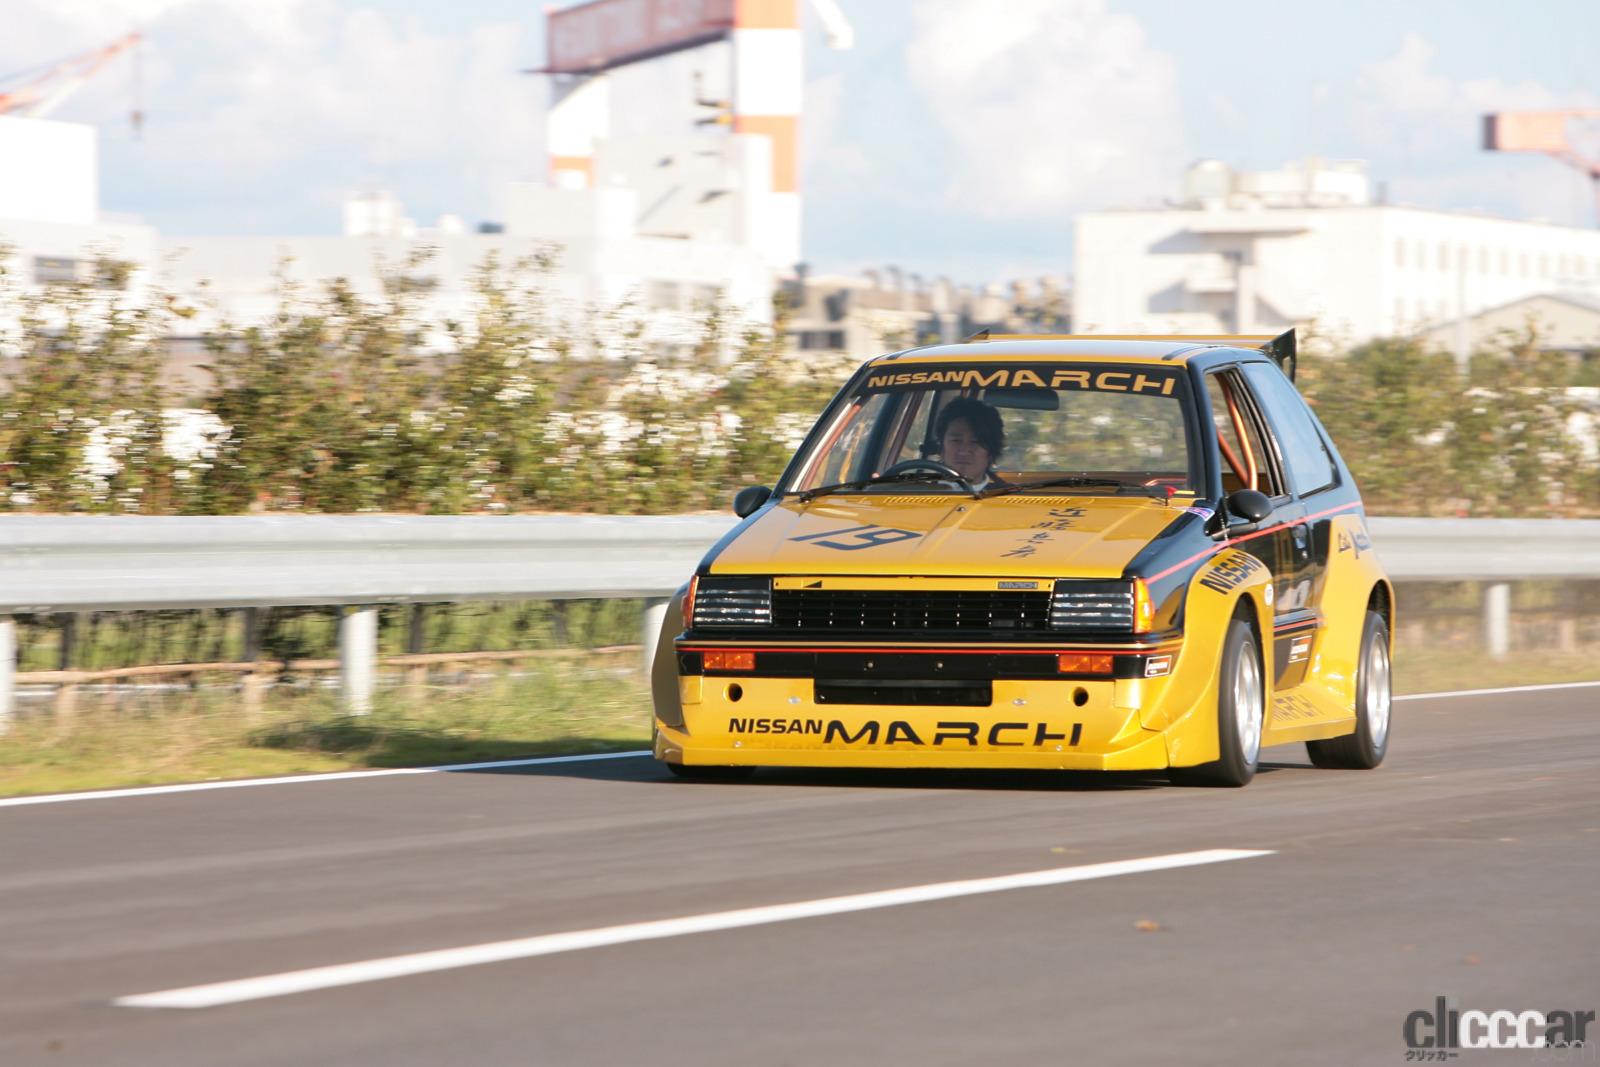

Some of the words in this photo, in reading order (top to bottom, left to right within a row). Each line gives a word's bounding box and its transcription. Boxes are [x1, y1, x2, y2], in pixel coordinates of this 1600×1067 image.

[867, 370, 964, 388] NISSAN
[961, 369, 1176, 395] MARCH
[1199, 551, 1263, 596] NISSAN
[728, 718, 822, 735] NISSAN
[823, 720, 1083, 747] MARCH
